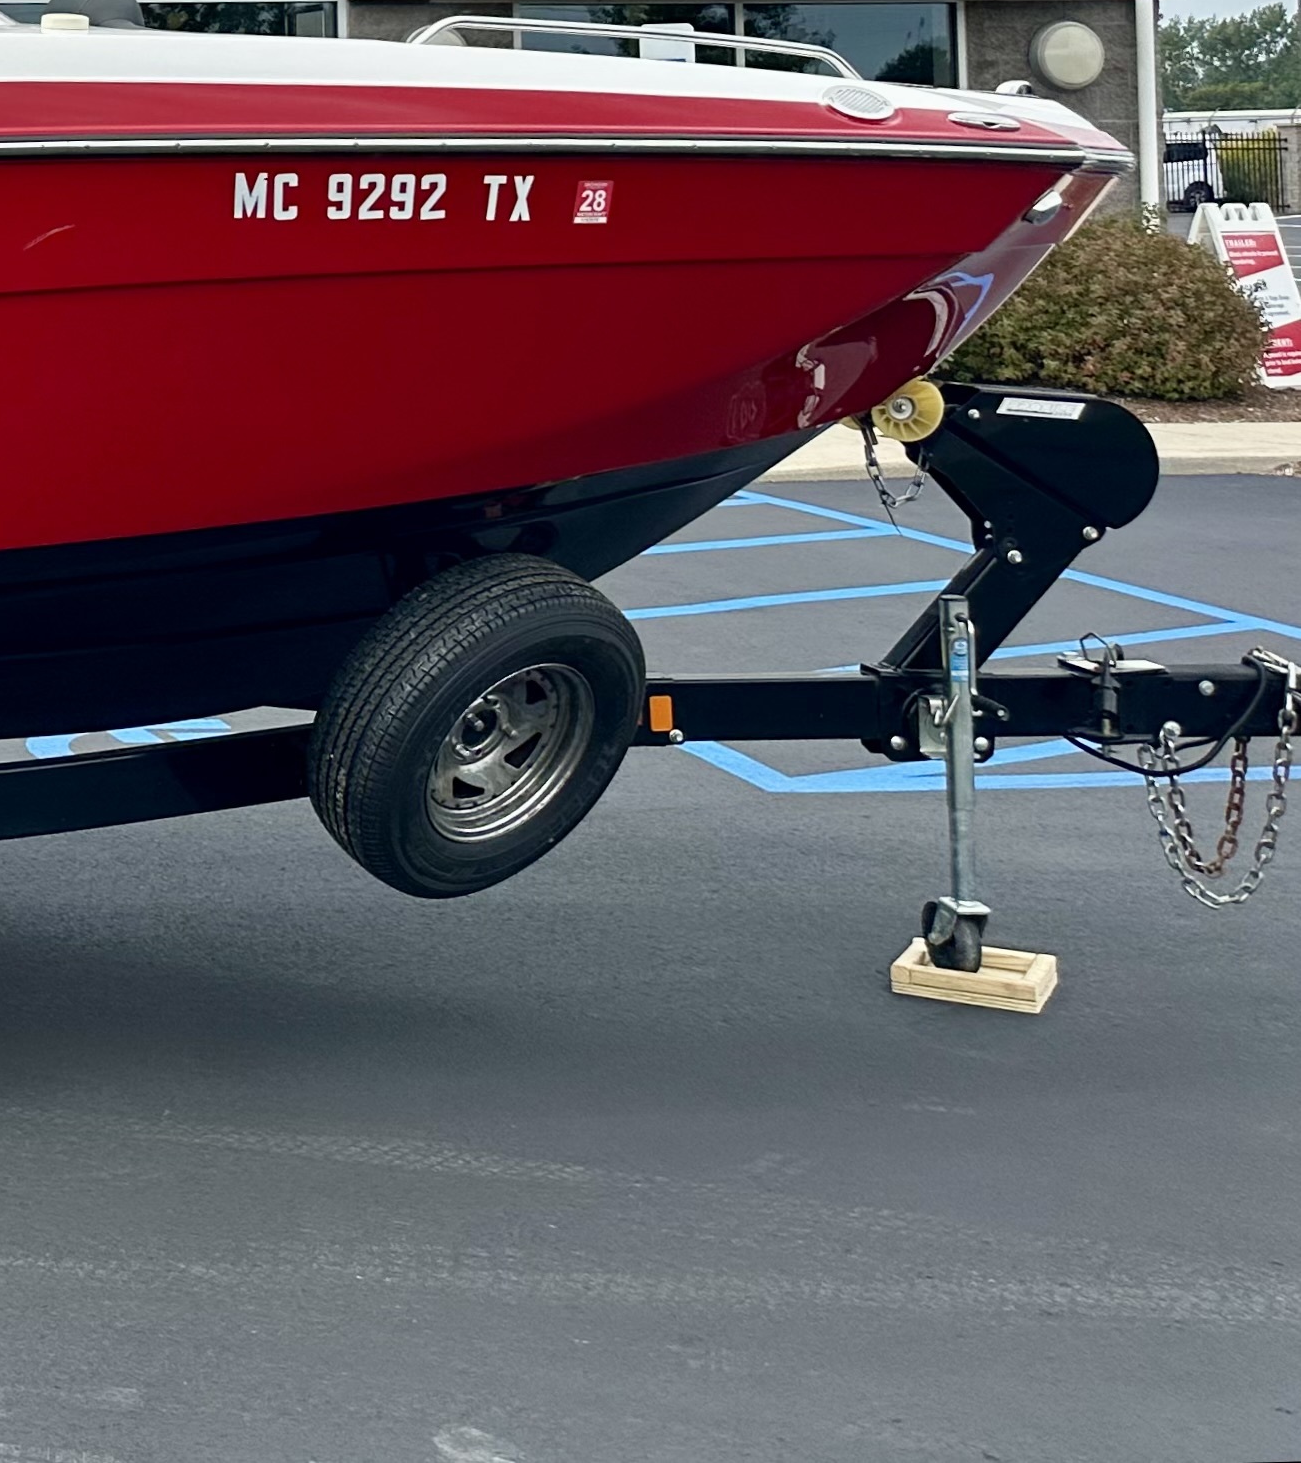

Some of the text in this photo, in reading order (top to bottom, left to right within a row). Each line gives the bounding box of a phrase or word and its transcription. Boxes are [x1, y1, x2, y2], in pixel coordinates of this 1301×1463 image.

[233, 172, 535, 222] MC 9292 TX
[579, 189, 607, 212] 28
